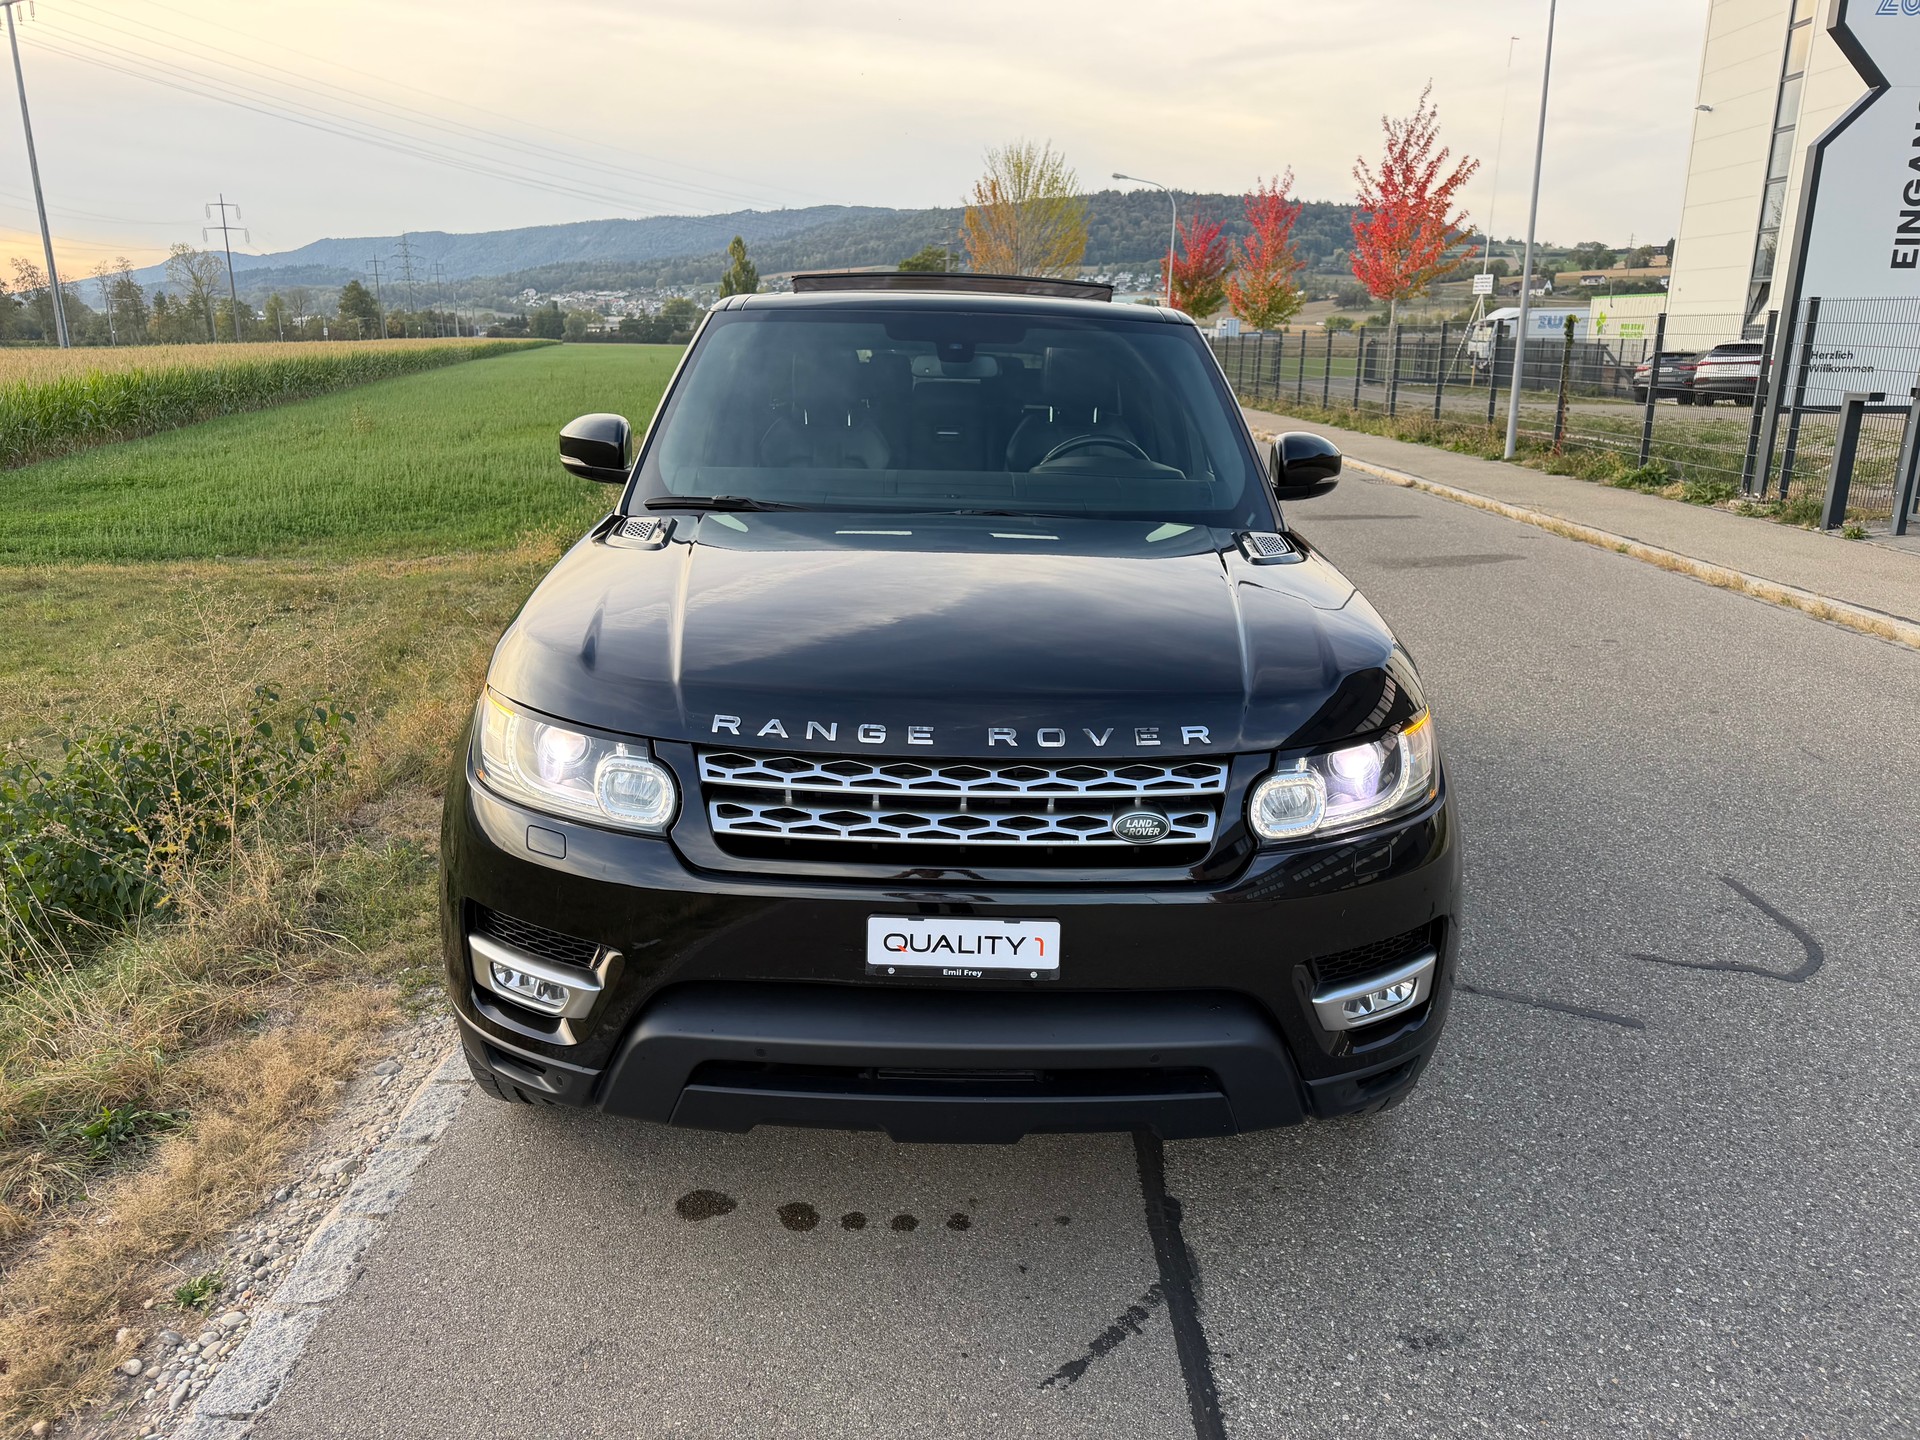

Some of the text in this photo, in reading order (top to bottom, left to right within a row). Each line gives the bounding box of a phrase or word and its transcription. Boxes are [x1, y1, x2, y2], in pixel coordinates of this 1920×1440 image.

[1810, 350, 1854, 360] Herzlich
[1808, 363, 1875, 373] Willkommen
[711, 714, 1212, 747] RANGE ROVER
[1126, 819, 1153, 828] LAND
[1128, 828, 1161, 836] ROVER
[883, 933, 1045, 956] QUALITY 1
[943, 969, 983, 978] Emil Frey
